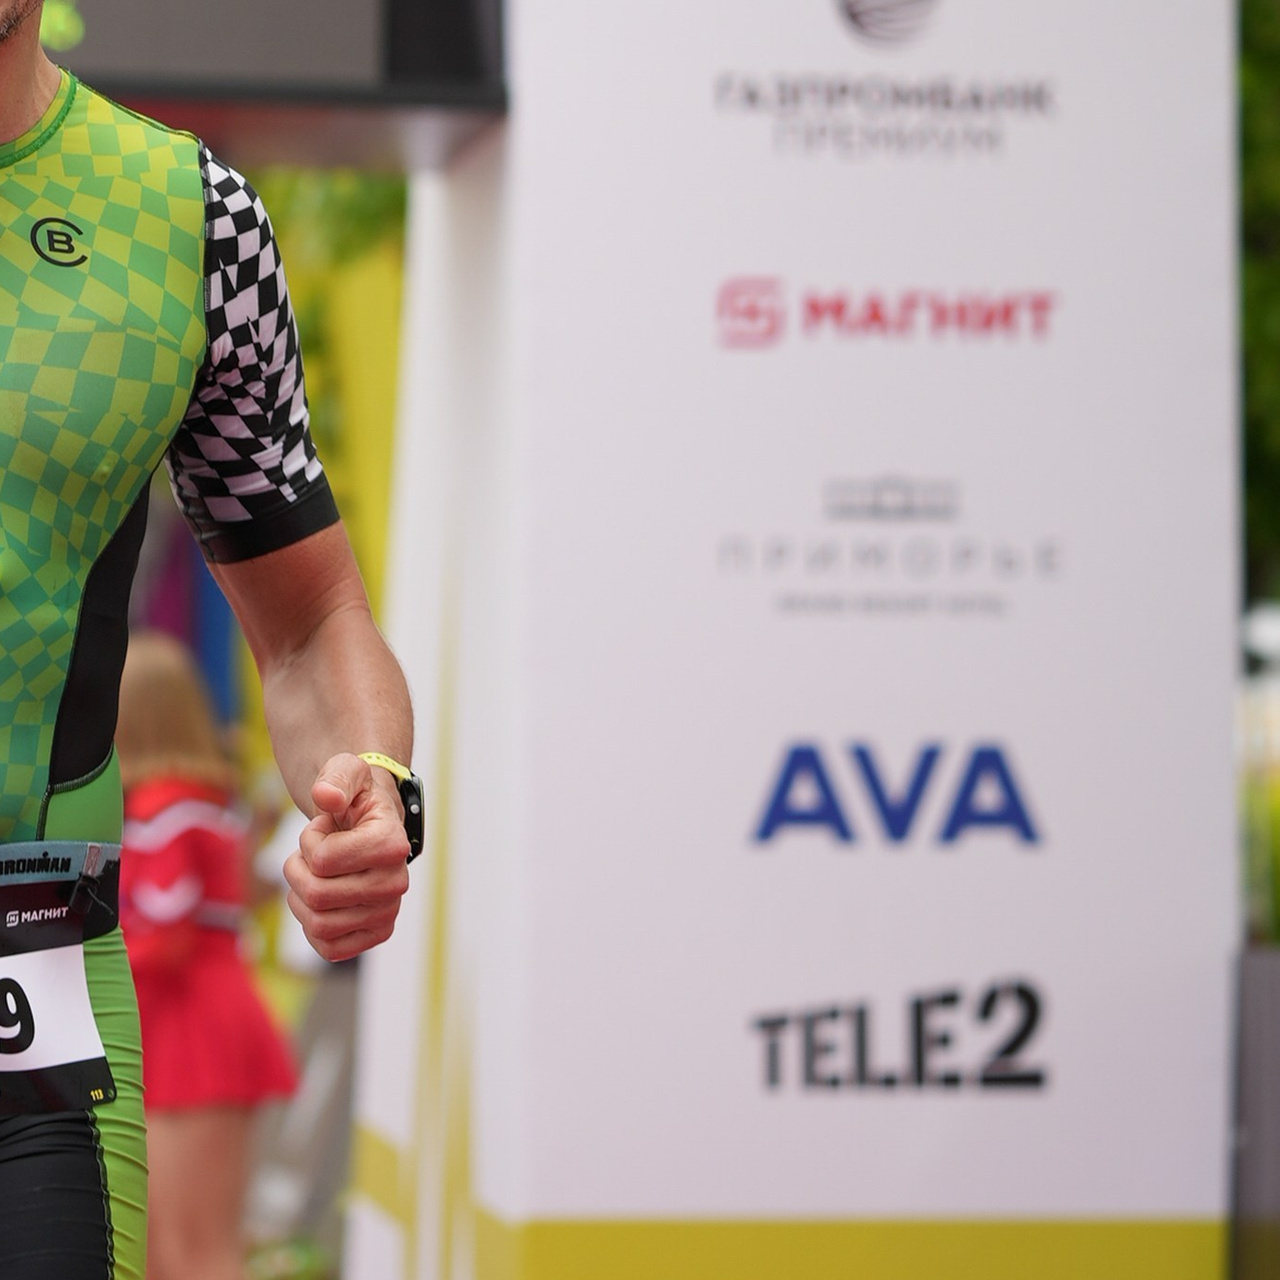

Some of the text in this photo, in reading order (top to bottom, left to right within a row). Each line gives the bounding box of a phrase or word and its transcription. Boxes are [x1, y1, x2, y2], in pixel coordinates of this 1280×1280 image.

[801, 291, 1056, 340] МАГНИТ
[752, 742, 1043, 846] AVA
[22, 907, 69, 923] МАГНИТ
[752, 980, 1048, 1093] TELE2
